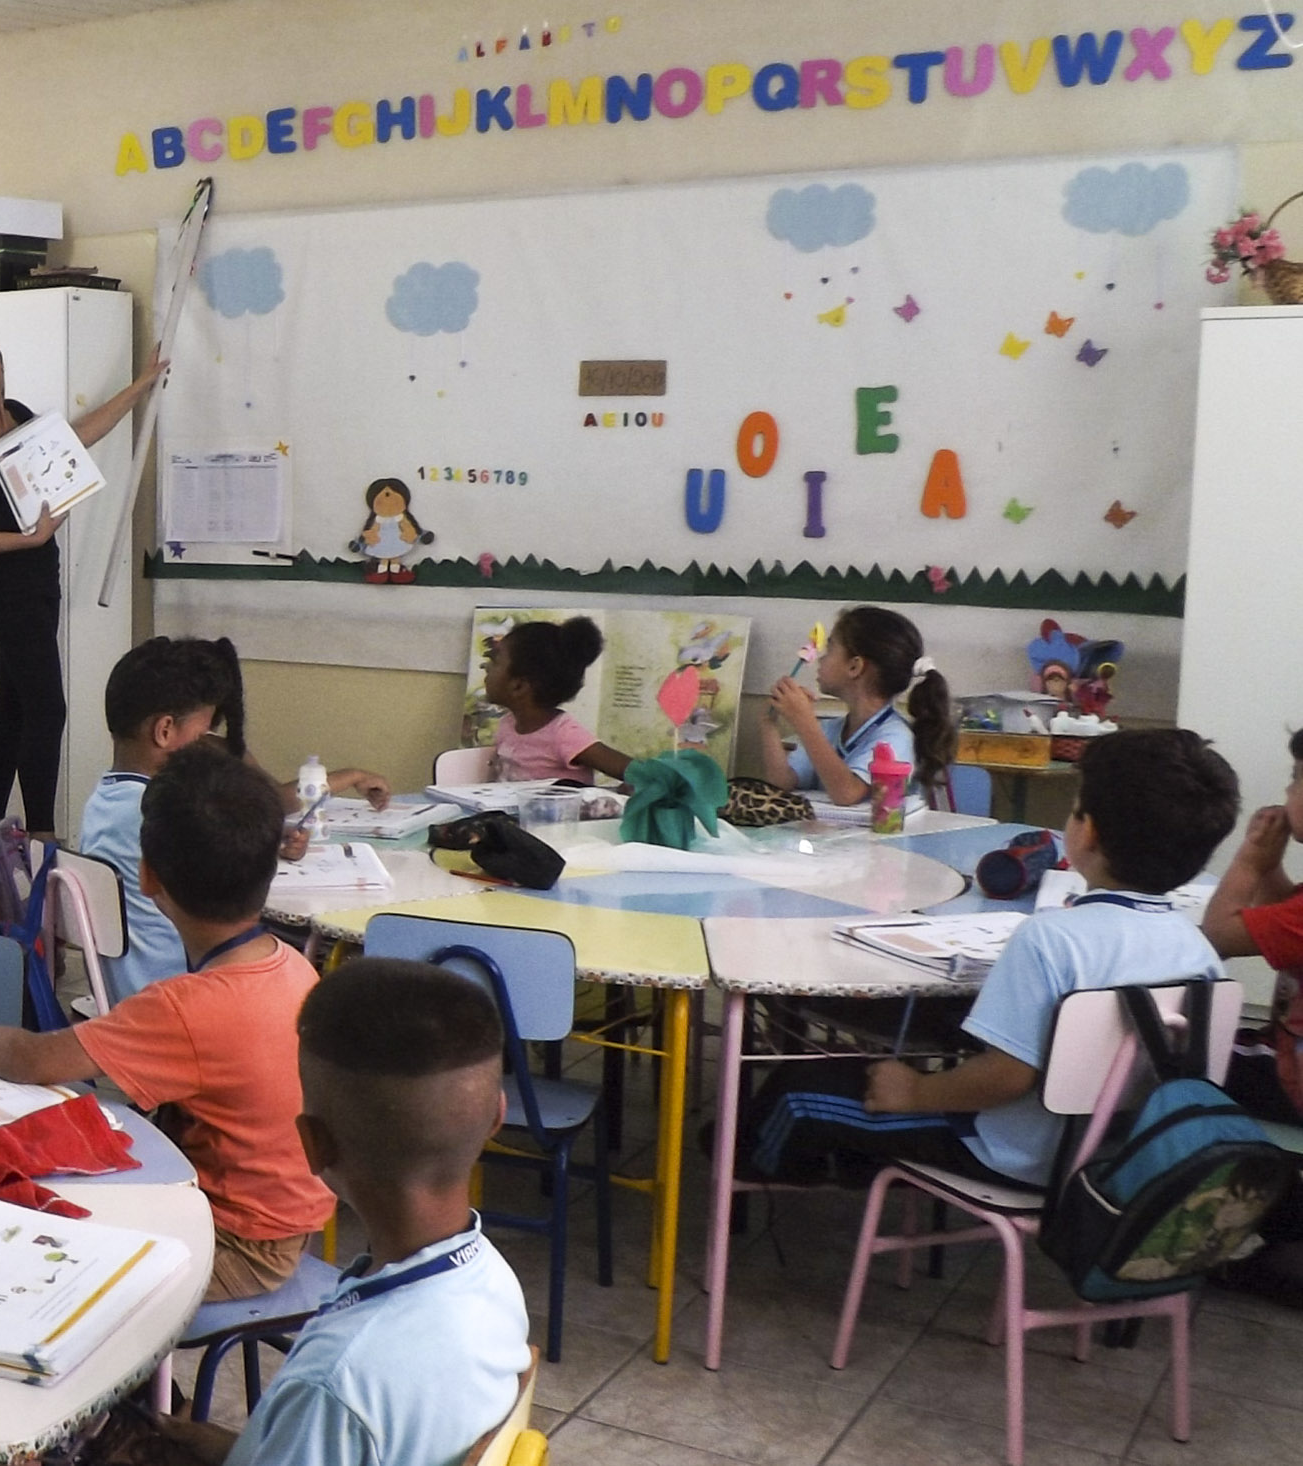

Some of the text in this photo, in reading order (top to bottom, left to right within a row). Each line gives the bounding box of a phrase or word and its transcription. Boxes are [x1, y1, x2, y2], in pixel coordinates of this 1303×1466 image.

[737, 411, 778, 478] O
[856, 385, 898, 454] E
[685, 468, 725, 534] U
[803, 471, 827, 538] I
[921, 449, 967, 519] A
